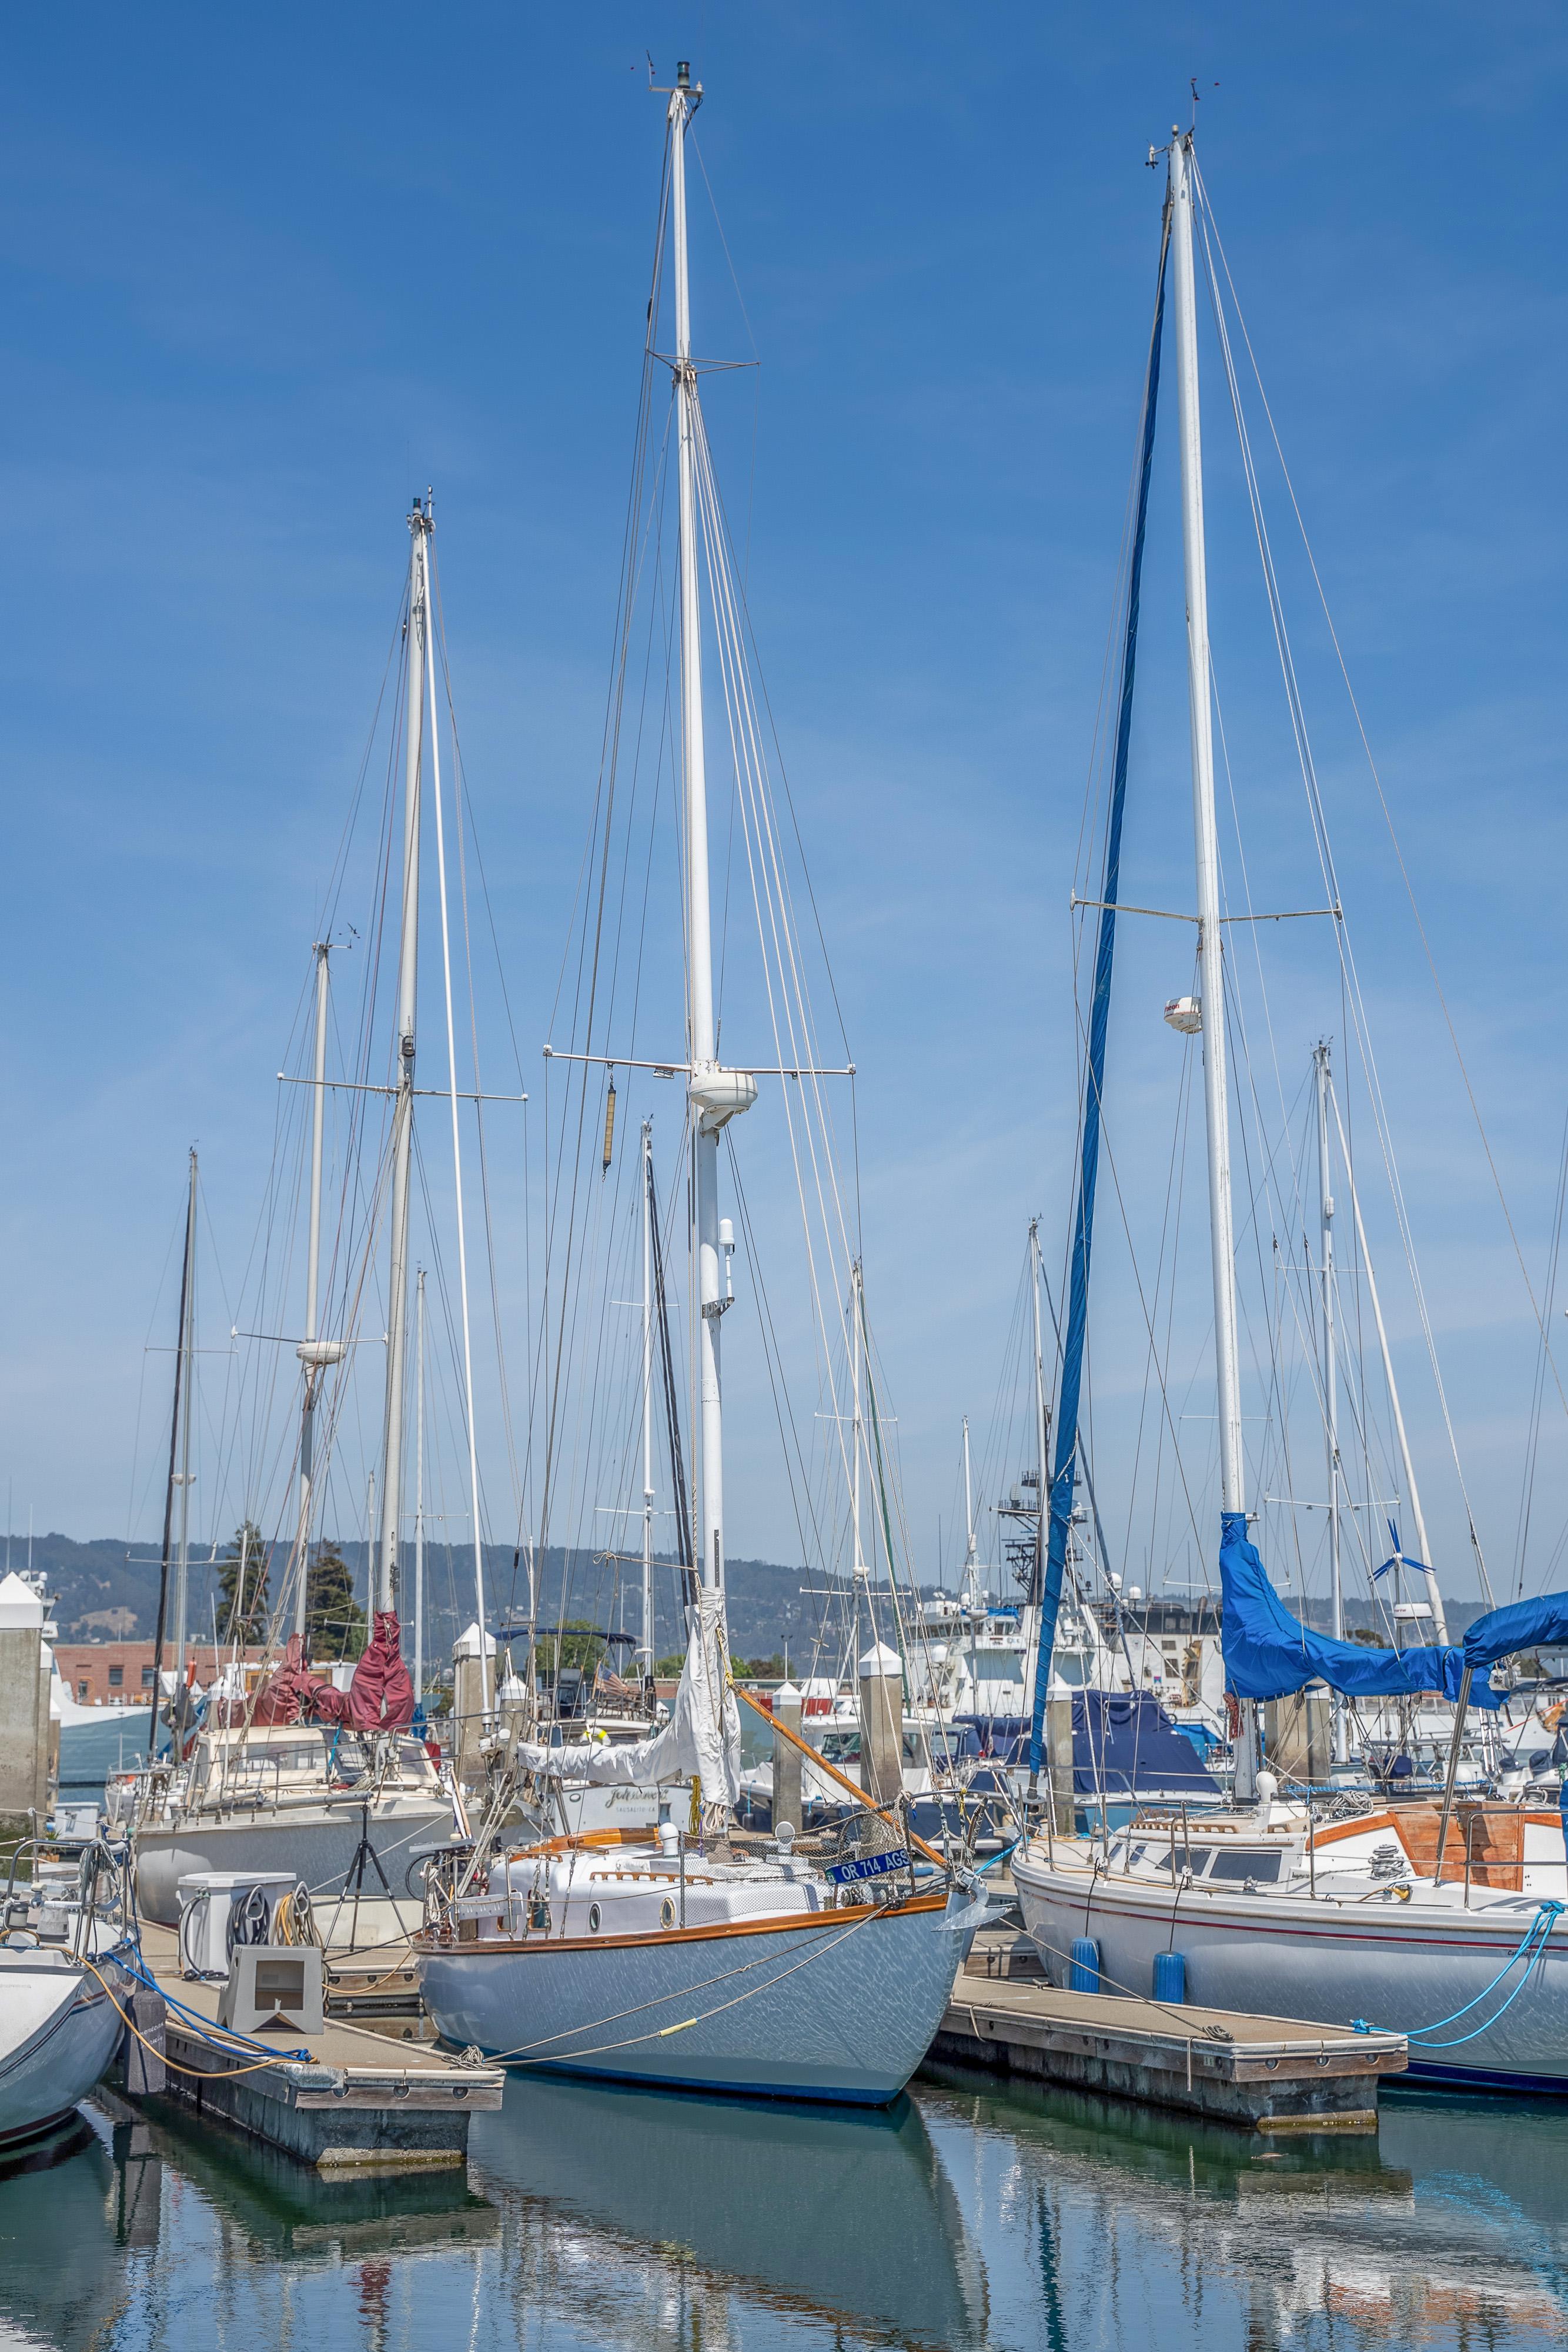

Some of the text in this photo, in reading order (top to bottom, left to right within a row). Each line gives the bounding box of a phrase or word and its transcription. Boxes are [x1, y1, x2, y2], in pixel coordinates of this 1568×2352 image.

[841, 1850, 910, 1880] OR 714 AGS
